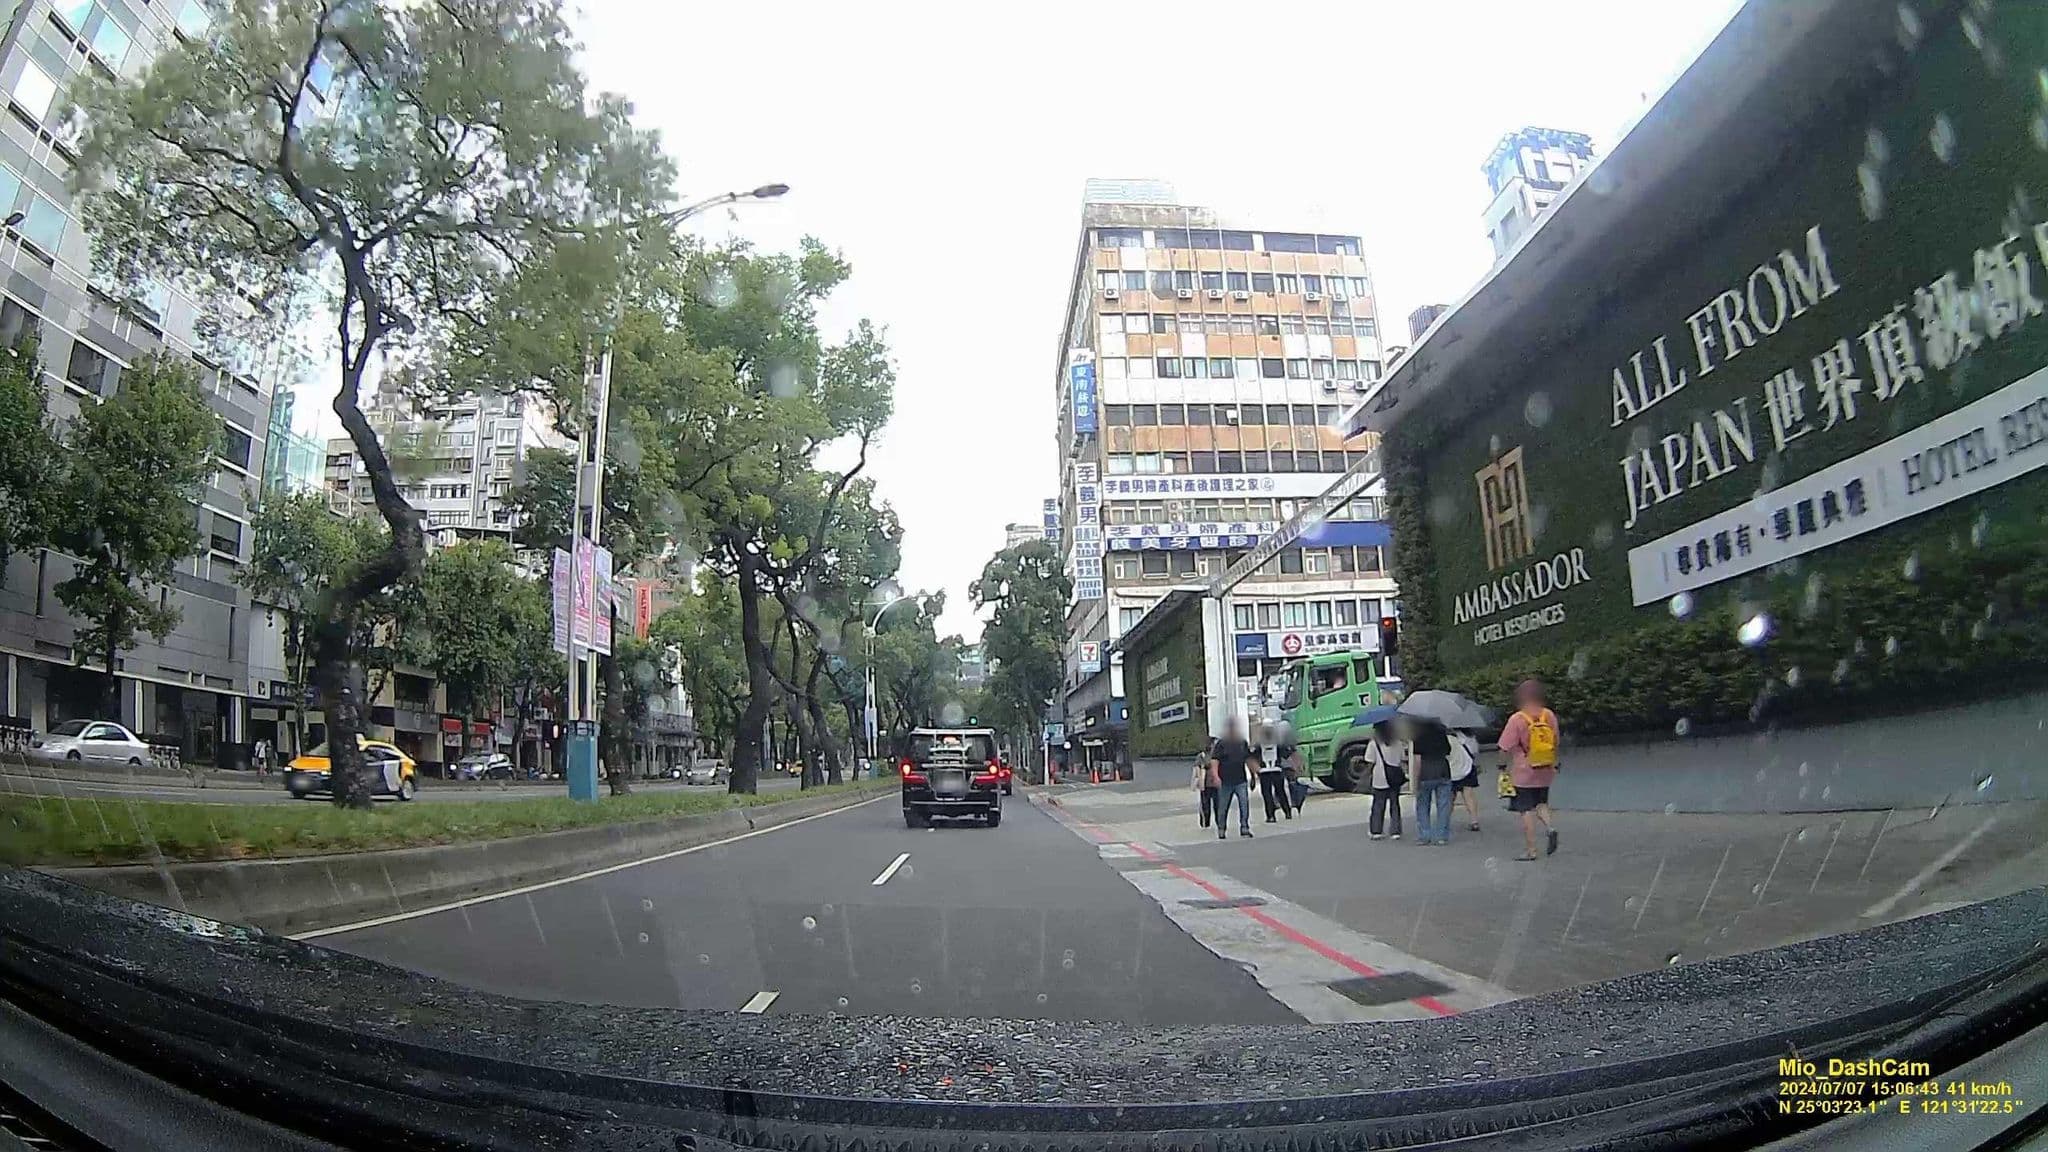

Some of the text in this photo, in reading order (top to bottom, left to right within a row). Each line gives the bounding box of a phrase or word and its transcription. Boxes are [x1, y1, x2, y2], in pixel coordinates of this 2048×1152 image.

[1610, 224, 1841, 428] ALL FROM
[1619, 221, 2048, 529] JAPAN 世界頂級飯
[1901, 427, 1998, 496] HOTEL
[1453, 547, 1592, 626] AMBASSADOR
[1474, 620, 1505, 646] HOTEL
